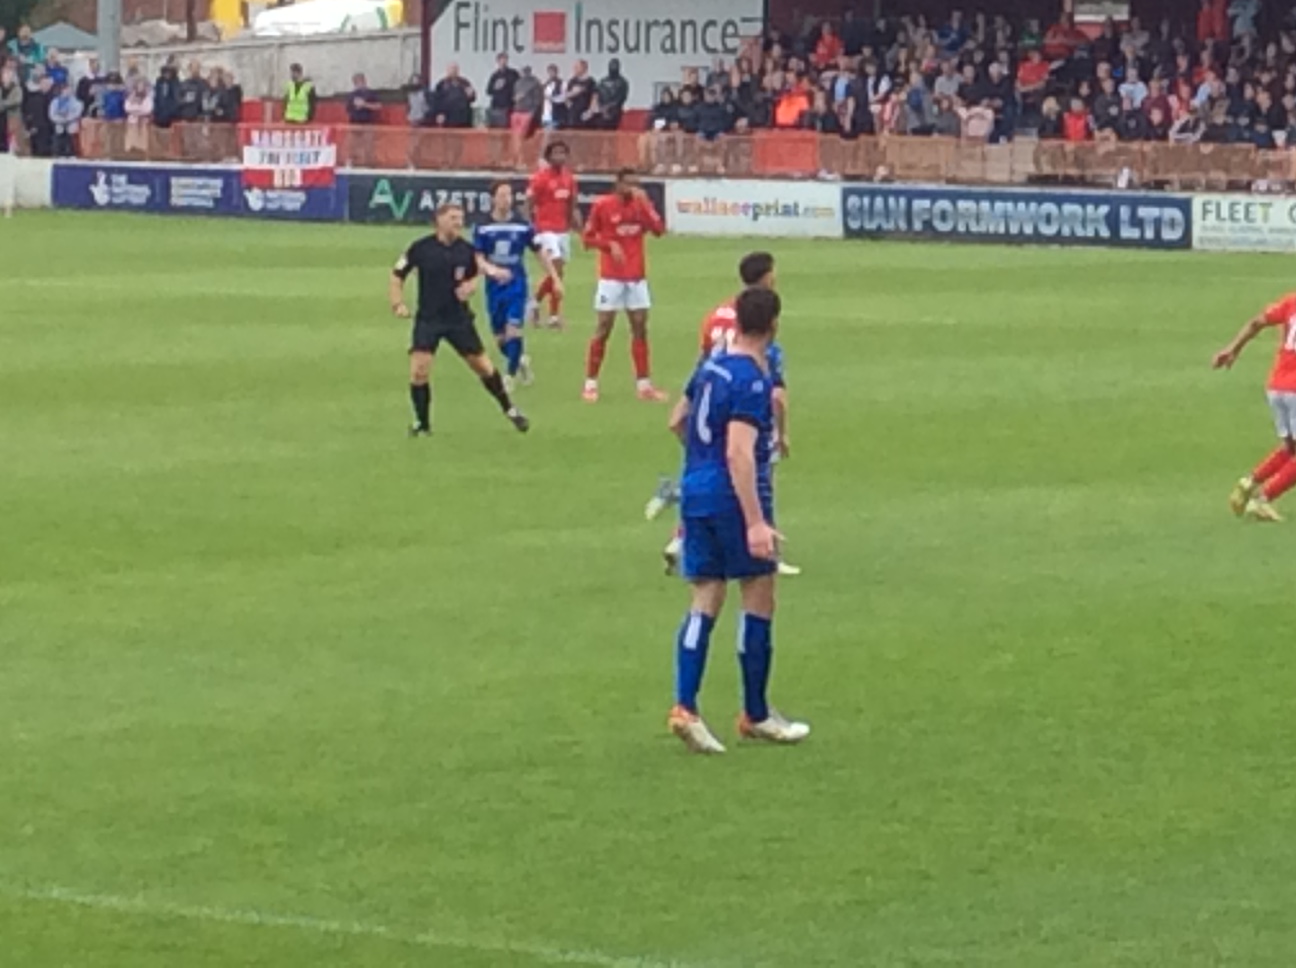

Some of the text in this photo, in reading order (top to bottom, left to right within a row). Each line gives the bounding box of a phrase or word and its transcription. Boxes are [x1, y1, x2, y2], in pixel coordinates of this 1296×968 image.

[454, 0, 740, 54] Flint Insurance
[911, 198, 1111, 238] FORMWORK
[1119, 205, 1186, 241] LTD
[1201, 200, 1273, 224] FLEET
